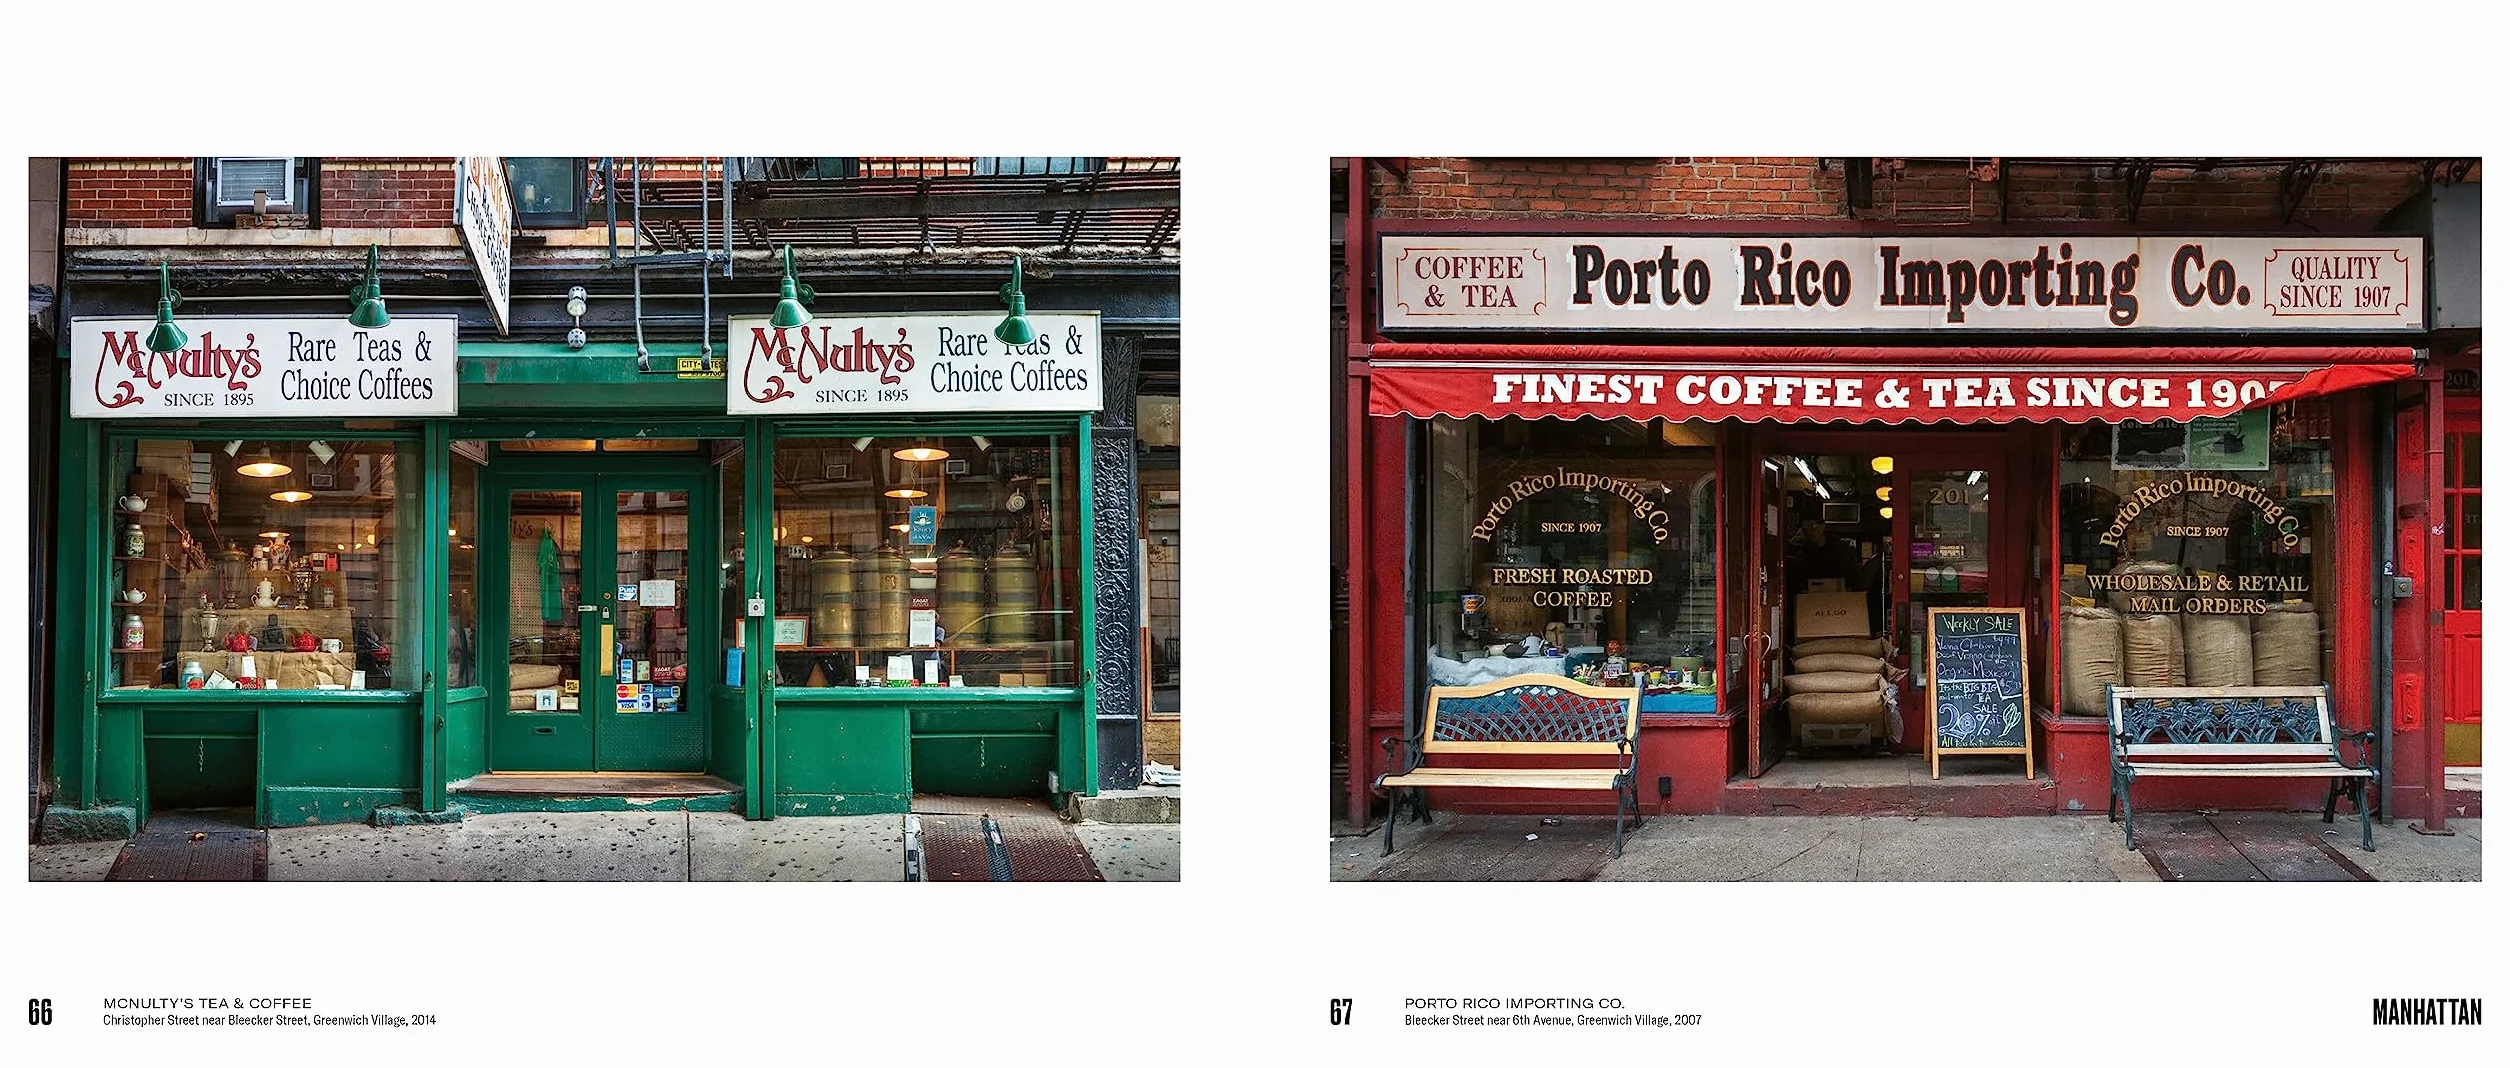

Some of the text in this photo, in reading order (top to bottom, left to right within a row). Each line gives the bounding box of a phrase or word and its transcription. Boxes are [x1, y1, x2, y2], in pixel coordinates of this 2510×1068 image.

[1415, 256, 1524, 279] COFFEE
[2290, 256, 2382, 283] QUALITY
[1572, 241, 2251, 327] Porto Rico Importing Co.
[1424, 284, 1518, 308] & TEA
[2280, 285, 2392, 308] SINCE 1907
[288, 331, 432, 362] Rare Teas &
[938, 327, 988, 357] Rare
[1065, 325, 1083, 355] &
[744, 326, 915, 404] McNulty's
[281, 369, 433, 401] Choice Coffees
[930, 360, 1088, 393] Choice Coffees
[164, 393, 254, 407] SINCE 1895
[815, 388, 909, 403] SINCE 1895
[1492, 374, 1664, 405] FINEST
[1676, 374, 1863, 408] COFFEE
[1874, 379, 1910, 408] &
[1922, 377, 2016, 408] TEA
[2027, 377, 2170, 408] SINCE
[1471, 466, 1670, 545] Porto Rico Importing Co.
[1929, 487, 1970, 505] 201
[2099, 471, 2299, 552] Porto Rico Importing Co.
[1541, 522, 1602, 533] SINCE 1907
[2167, 526, 2230, 537] SINCE 1907
[1492, 568, 1653, 585] FRESH ROASTED
[2087, 574, 2310, 592] WHOLESALE & RETAIL
[1533, 591, 1613, 608] COFFEE
[2130, 597, 2268, 614] MAIL ORDERS
[1984, 615, 2014, 632] SALE
[1962, 682, 1980, 693] BIG
[1981, 682, 1998, 693] BIG
[1975, 692, 1992, 703] TEA
[1972, 703, 1998, 714] SALE
